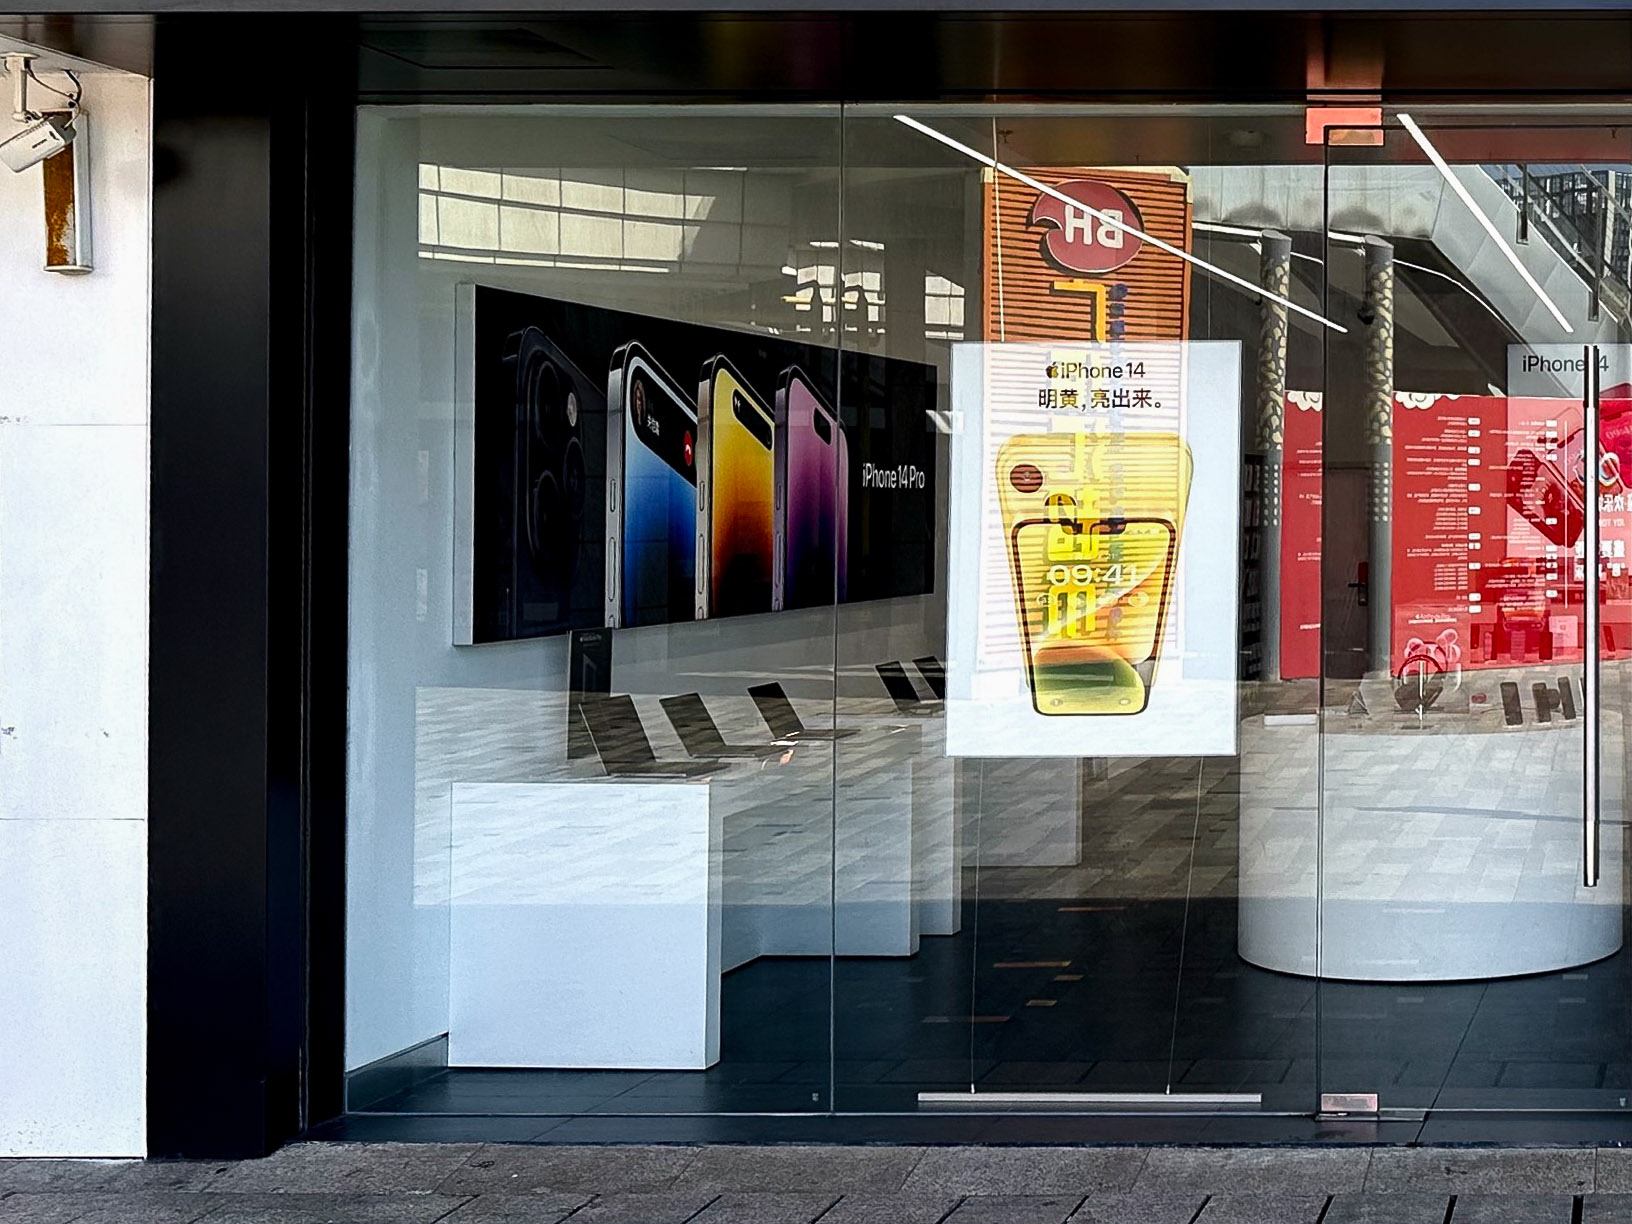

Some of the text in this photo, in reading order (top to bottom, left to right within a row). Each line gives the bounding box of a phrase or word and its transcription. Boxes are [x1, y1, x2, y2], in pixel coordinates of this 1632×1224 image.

[1060, 361, 1146, 381] iPhone 14
[1522, 354, 1584, 372] iPhone
[862, 462, 897, 489] iPhone
[910, 465, 926, 489] Pro
